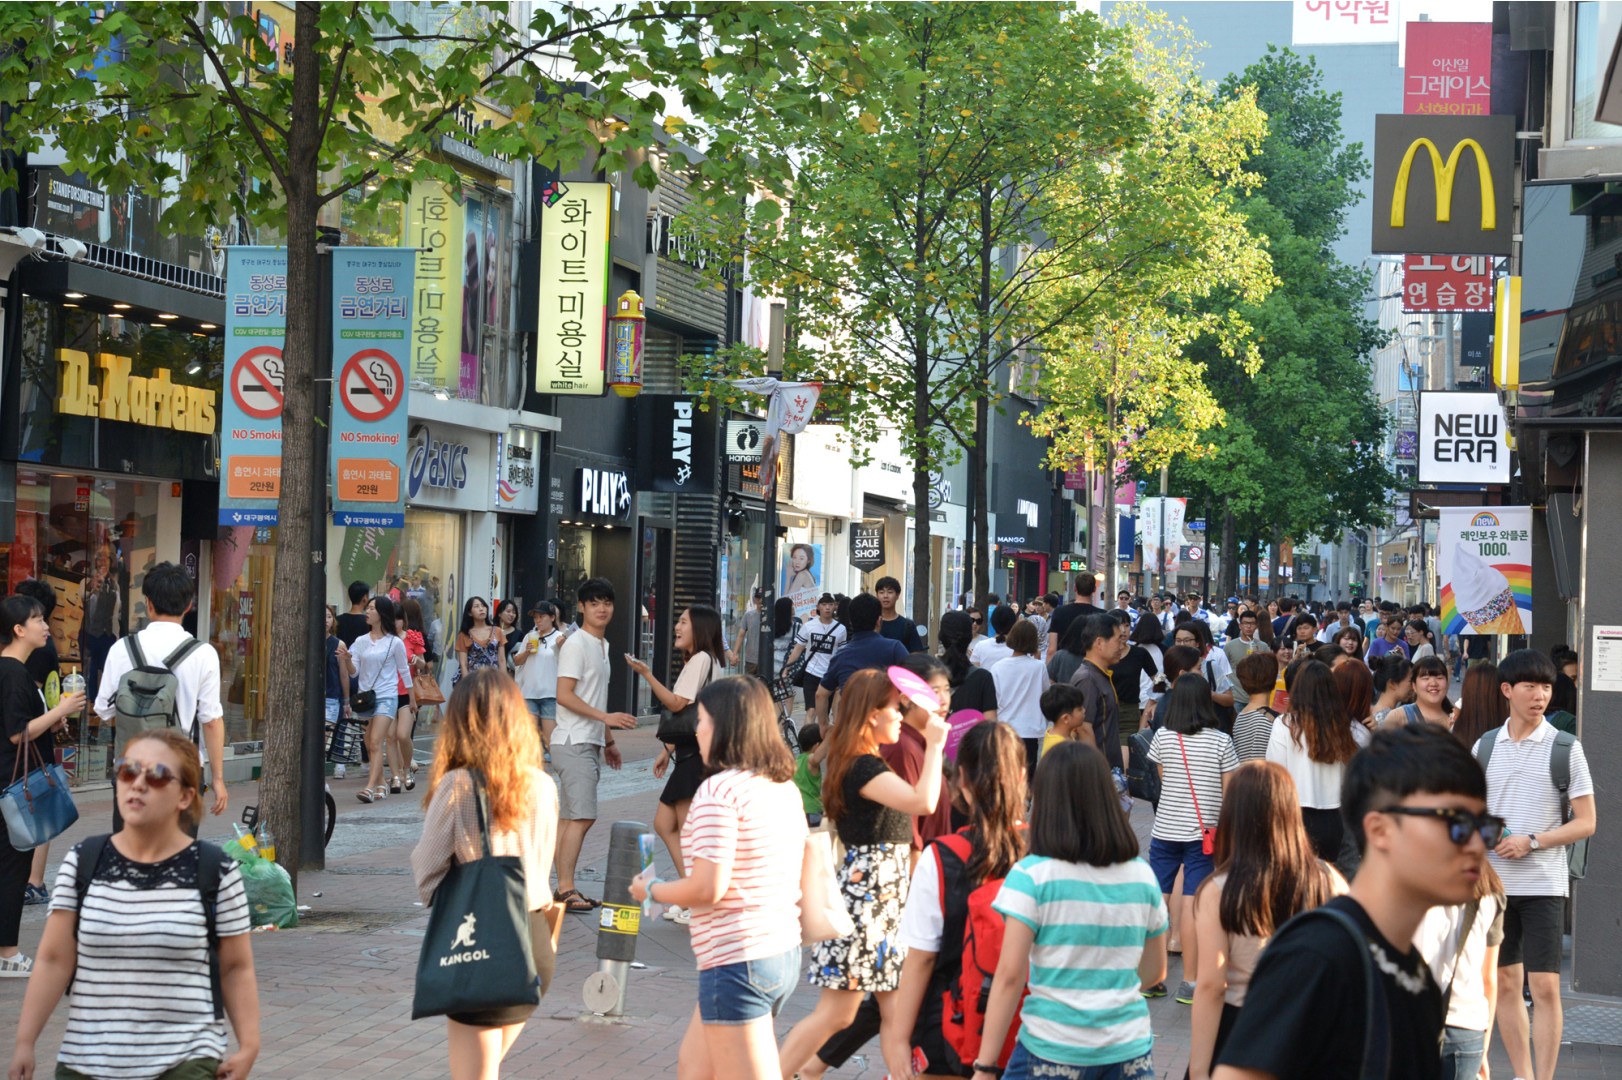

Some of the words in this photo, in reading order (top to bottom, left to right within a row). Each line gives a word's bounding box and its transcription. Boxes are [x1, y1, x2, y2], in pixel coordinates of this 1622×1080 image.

[1406, 75, 1491, 98] 그레이스
[250, 275, 287, 292] 동성로
[356, 277, 394, 294] 동성로
[1408, 282, 1487, 306] 연습장
[234, 294, 287, 316] 금연거
[340, 296, 407, 319] 금연거리
[550, 381, 573, 389] white
[1434, 414, 1498, 438] NEW
[232, 429, 248, 439] NO
[249, 429, 283, 439] Smoki
[341, 432, 355, 442] NO
[356, 432, 400, 446] Smoking!
[1434, 439, 1497, 463] ERA
[263, 466, 282, 478] 과태
[428, 441, 469, 490] asics
[250, 481, 275, 492] 2만원
[356, 484, 378, 495] 2만원
[1476, 517, 1495, 526] new
[856, 529, 879, 537] TATE
[1460, 530, 1498, 541] 레인보우
[1500, 529, 1528, 541] 와플콘
[855, 538, 879, 548] SALE
[1478, 542, 1507, 556] 1000
[855, 549, 880, 558] SHOP
[239, 597, 253, 616] SALE
[439, 949, 490, 967] KANGOL
